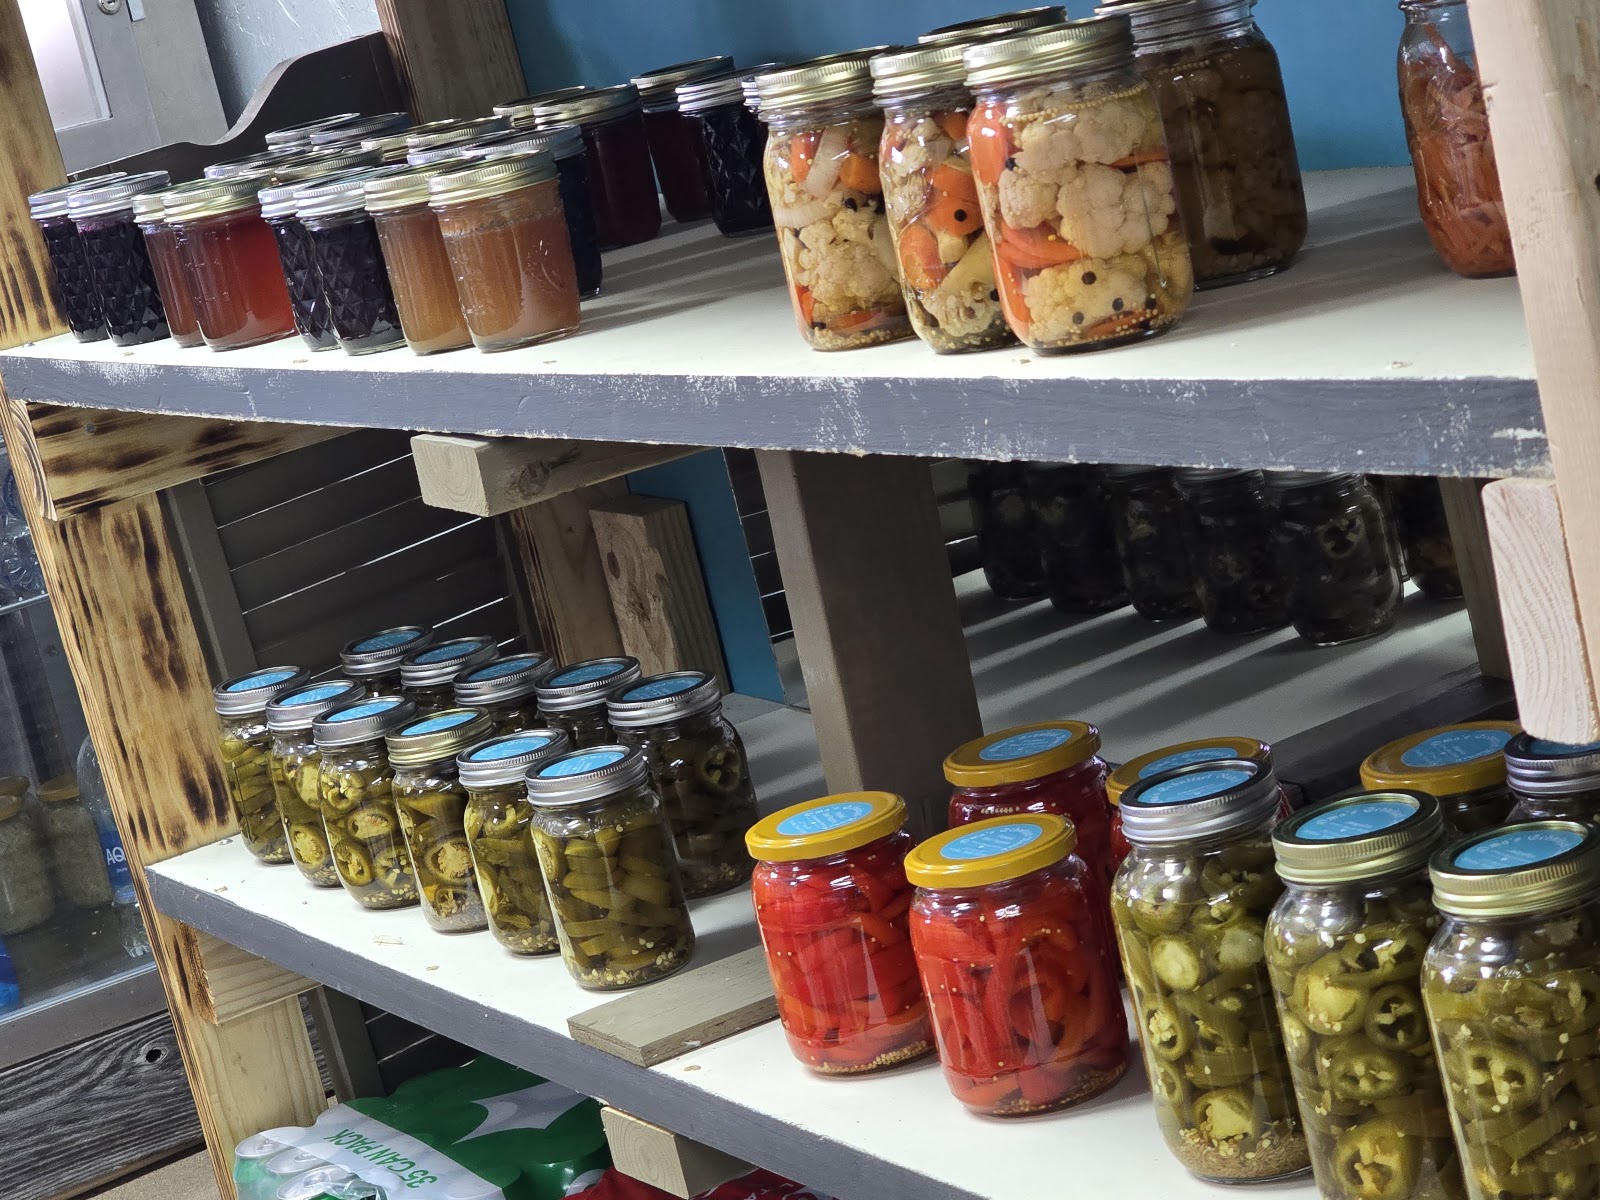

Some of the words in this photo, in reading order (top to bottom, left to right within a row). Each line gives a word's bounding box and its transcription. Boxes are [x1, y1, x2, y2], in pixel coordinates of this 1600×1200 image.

[323, 1128, 376, 1154] PACK
[363, 1144, 416, 1172] CAN
[400, 1169, 438, 1188] 35
